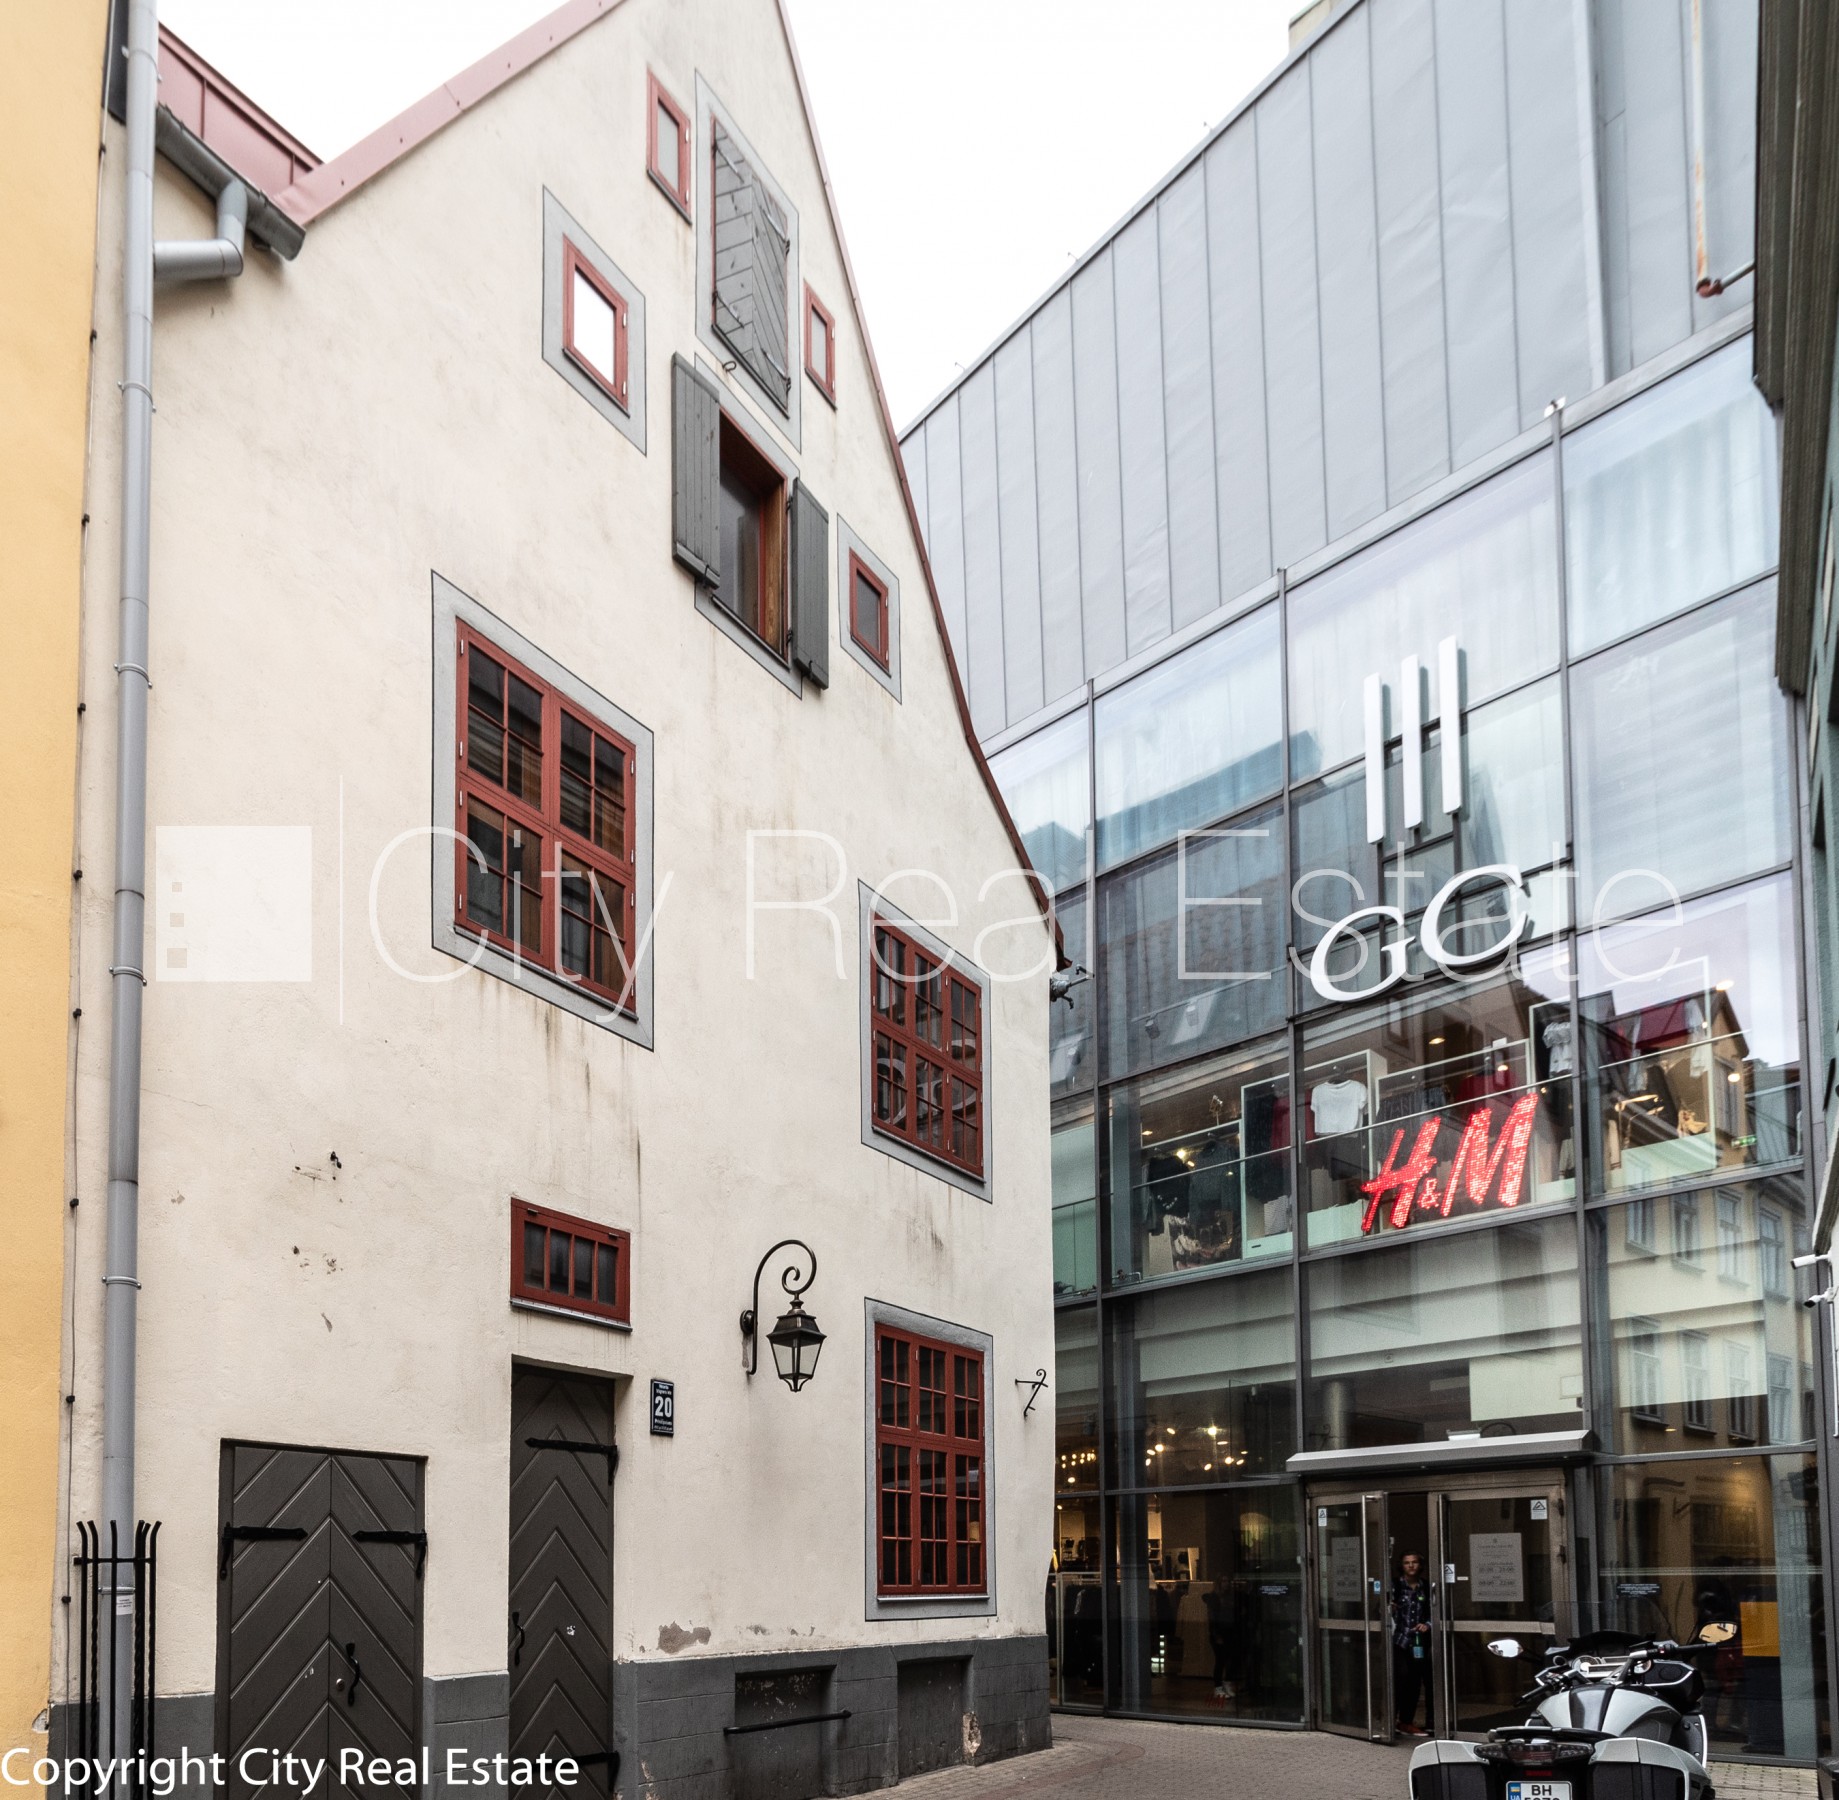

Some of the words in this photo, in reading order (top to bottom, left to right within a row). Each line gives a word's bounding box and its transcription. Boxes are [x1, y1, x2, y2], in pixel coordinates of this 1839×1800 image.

[1361, 1093, 1538, 1232] H&M
[655, 1396, 672, 1417] 20
[1531, 1785, 1552, 1796] BH
